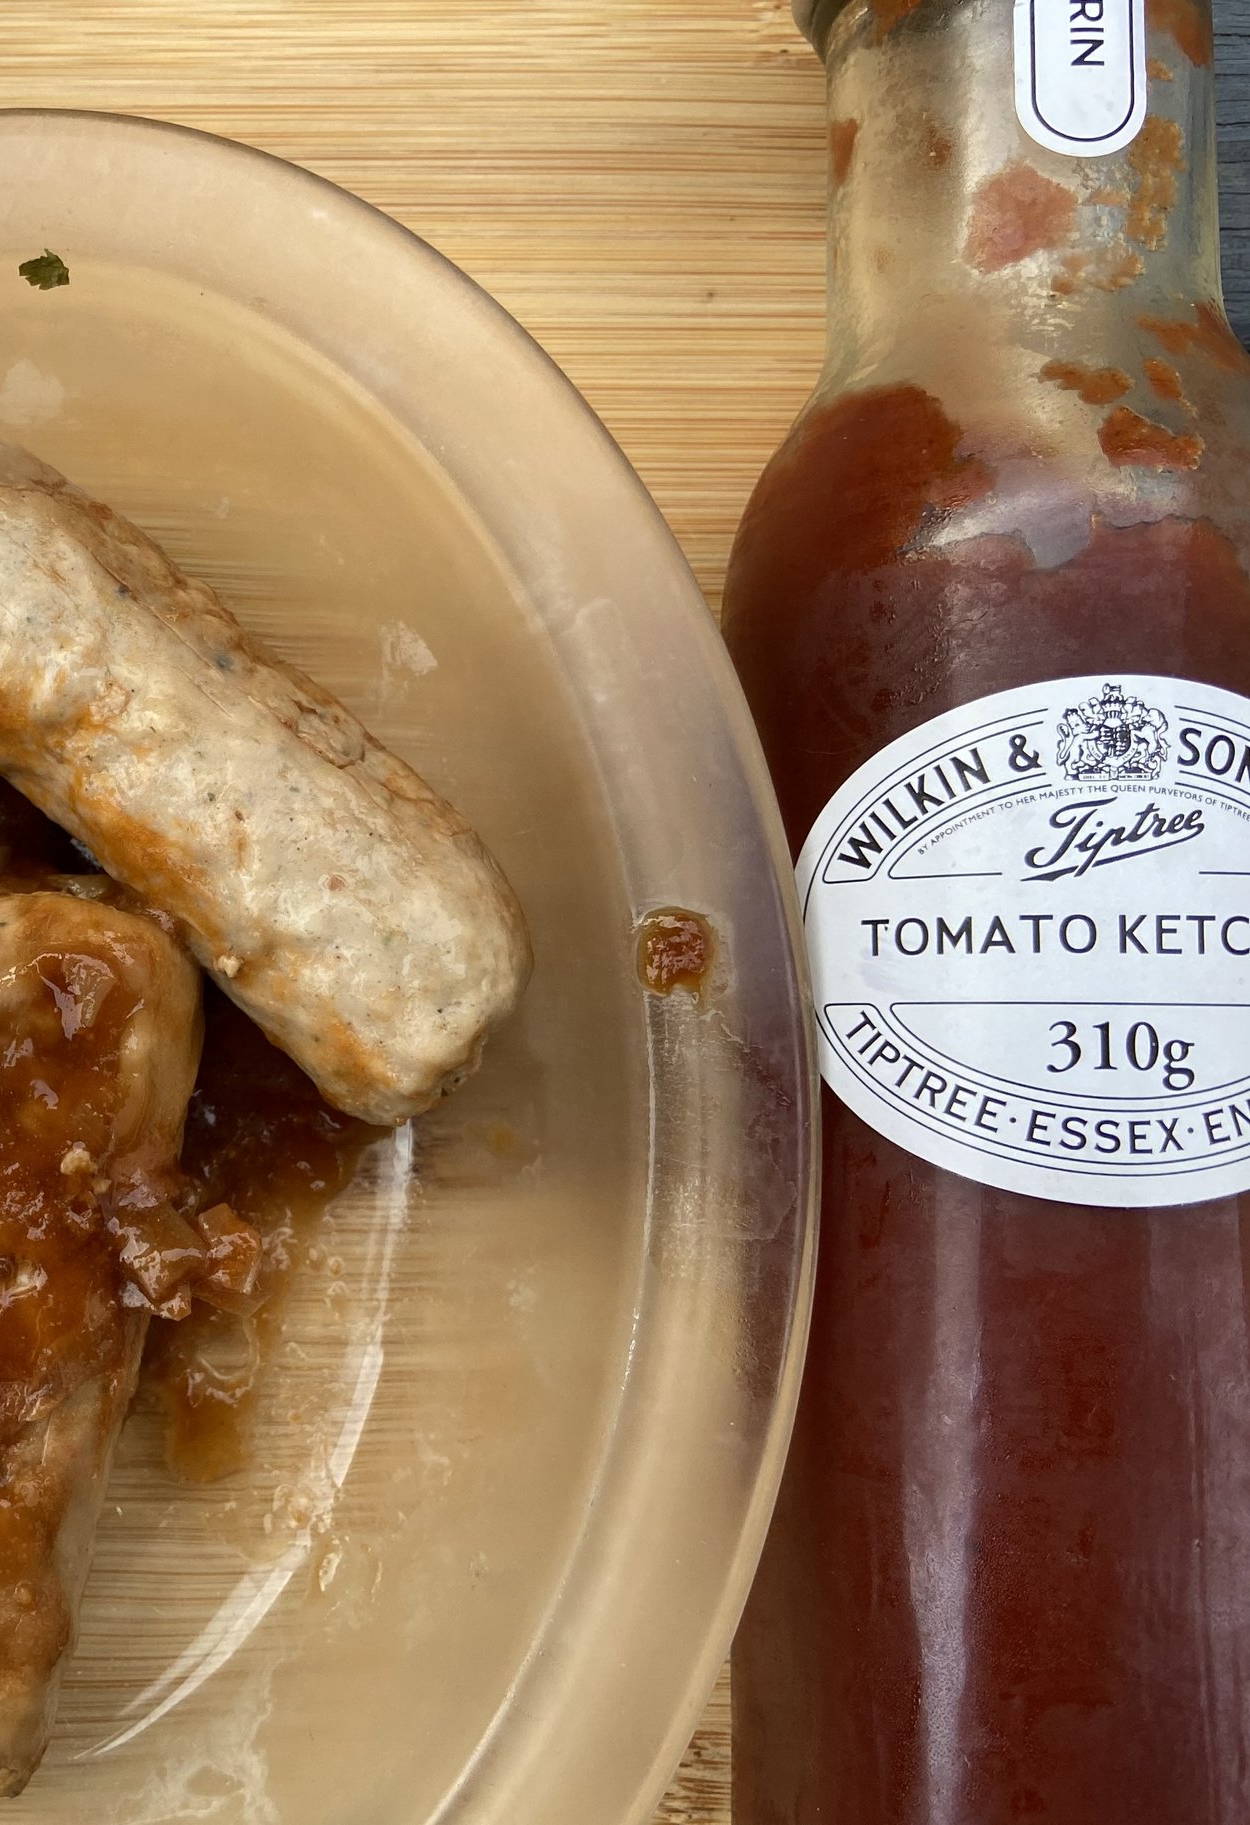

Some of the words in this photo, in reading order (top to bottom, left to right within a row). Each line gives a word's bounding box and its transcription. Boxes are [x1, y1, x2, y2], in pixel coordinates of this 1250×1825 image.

[837, 746, 991, 870] WILKIN
[1008, 734, 1043, 773] &
[917, 844, 929, 855] BY
[930, 807, 996, 846] APPOINTMENT
[996, 800, 1013, 811] TO
[1016, 795, 1036, 806] HER
[1039, 787, 1084, 801] MAJESTY
[1088, 785, 1107, 793] THE
[1111, 784, 1146, 793] QUEEN
[1149, 786, 1203, 803] PURVEYORS
[1204, 797, 1218, 807] OF
[1023, 797, 1205, 879] Tiptree
[860, 914, 1097, 957] TOMATO
[1119, 914, 1250, 956] KETC
[1047, 1020, 1195, 1092] 310g
